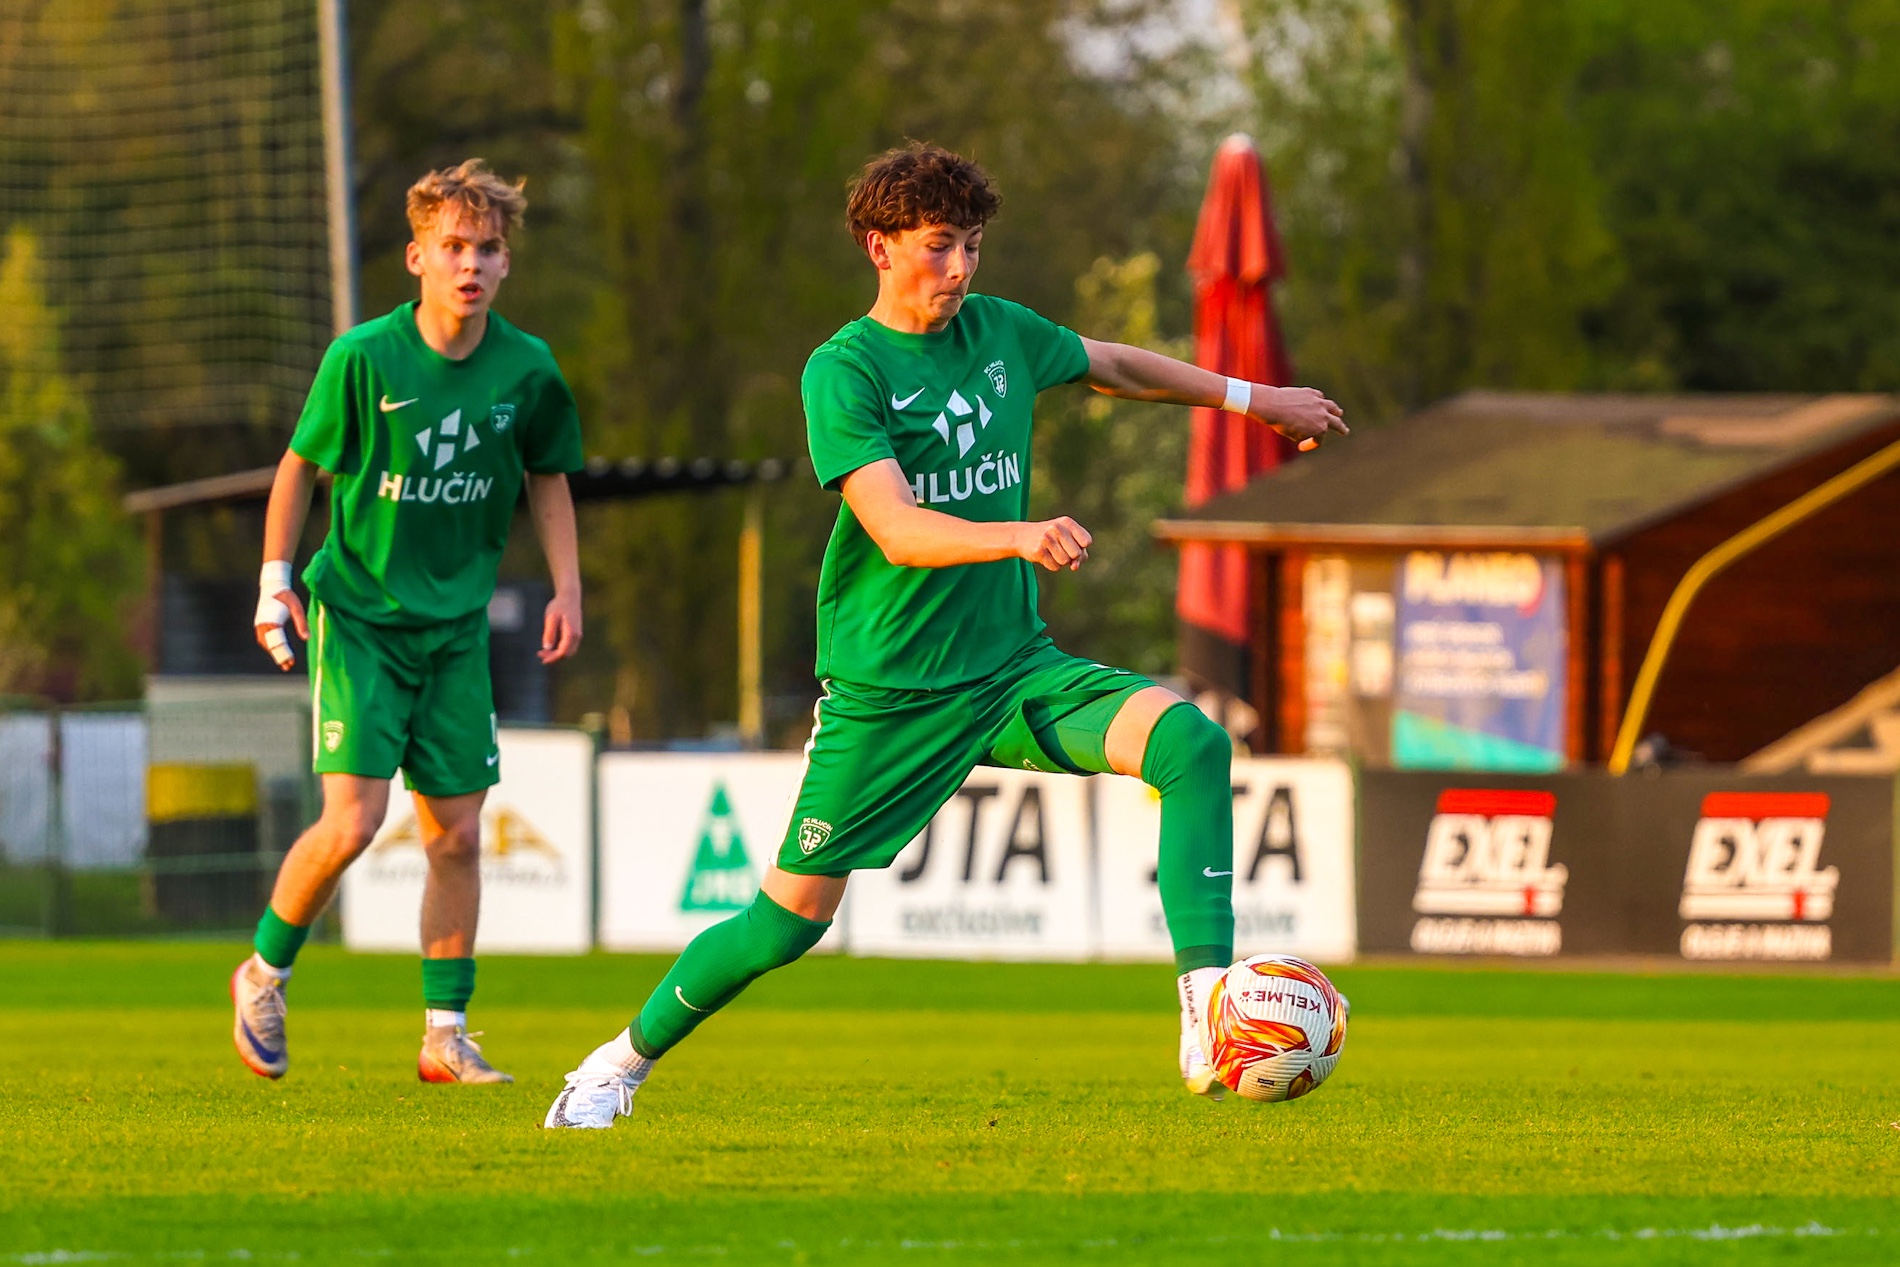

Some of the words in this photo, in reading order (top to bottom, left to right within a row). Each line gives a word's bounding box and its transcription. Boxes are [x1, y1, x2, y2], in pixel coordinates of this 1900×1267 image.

[377, 470, 494, 504] HLUČÍN
[910, 449, 1020, 504] HLUČÍN
[899, 785, 1051, 885] JTA
[901, 900, 1043, 936] exclusive
[1254, 990, 1321, 1014] KELME
